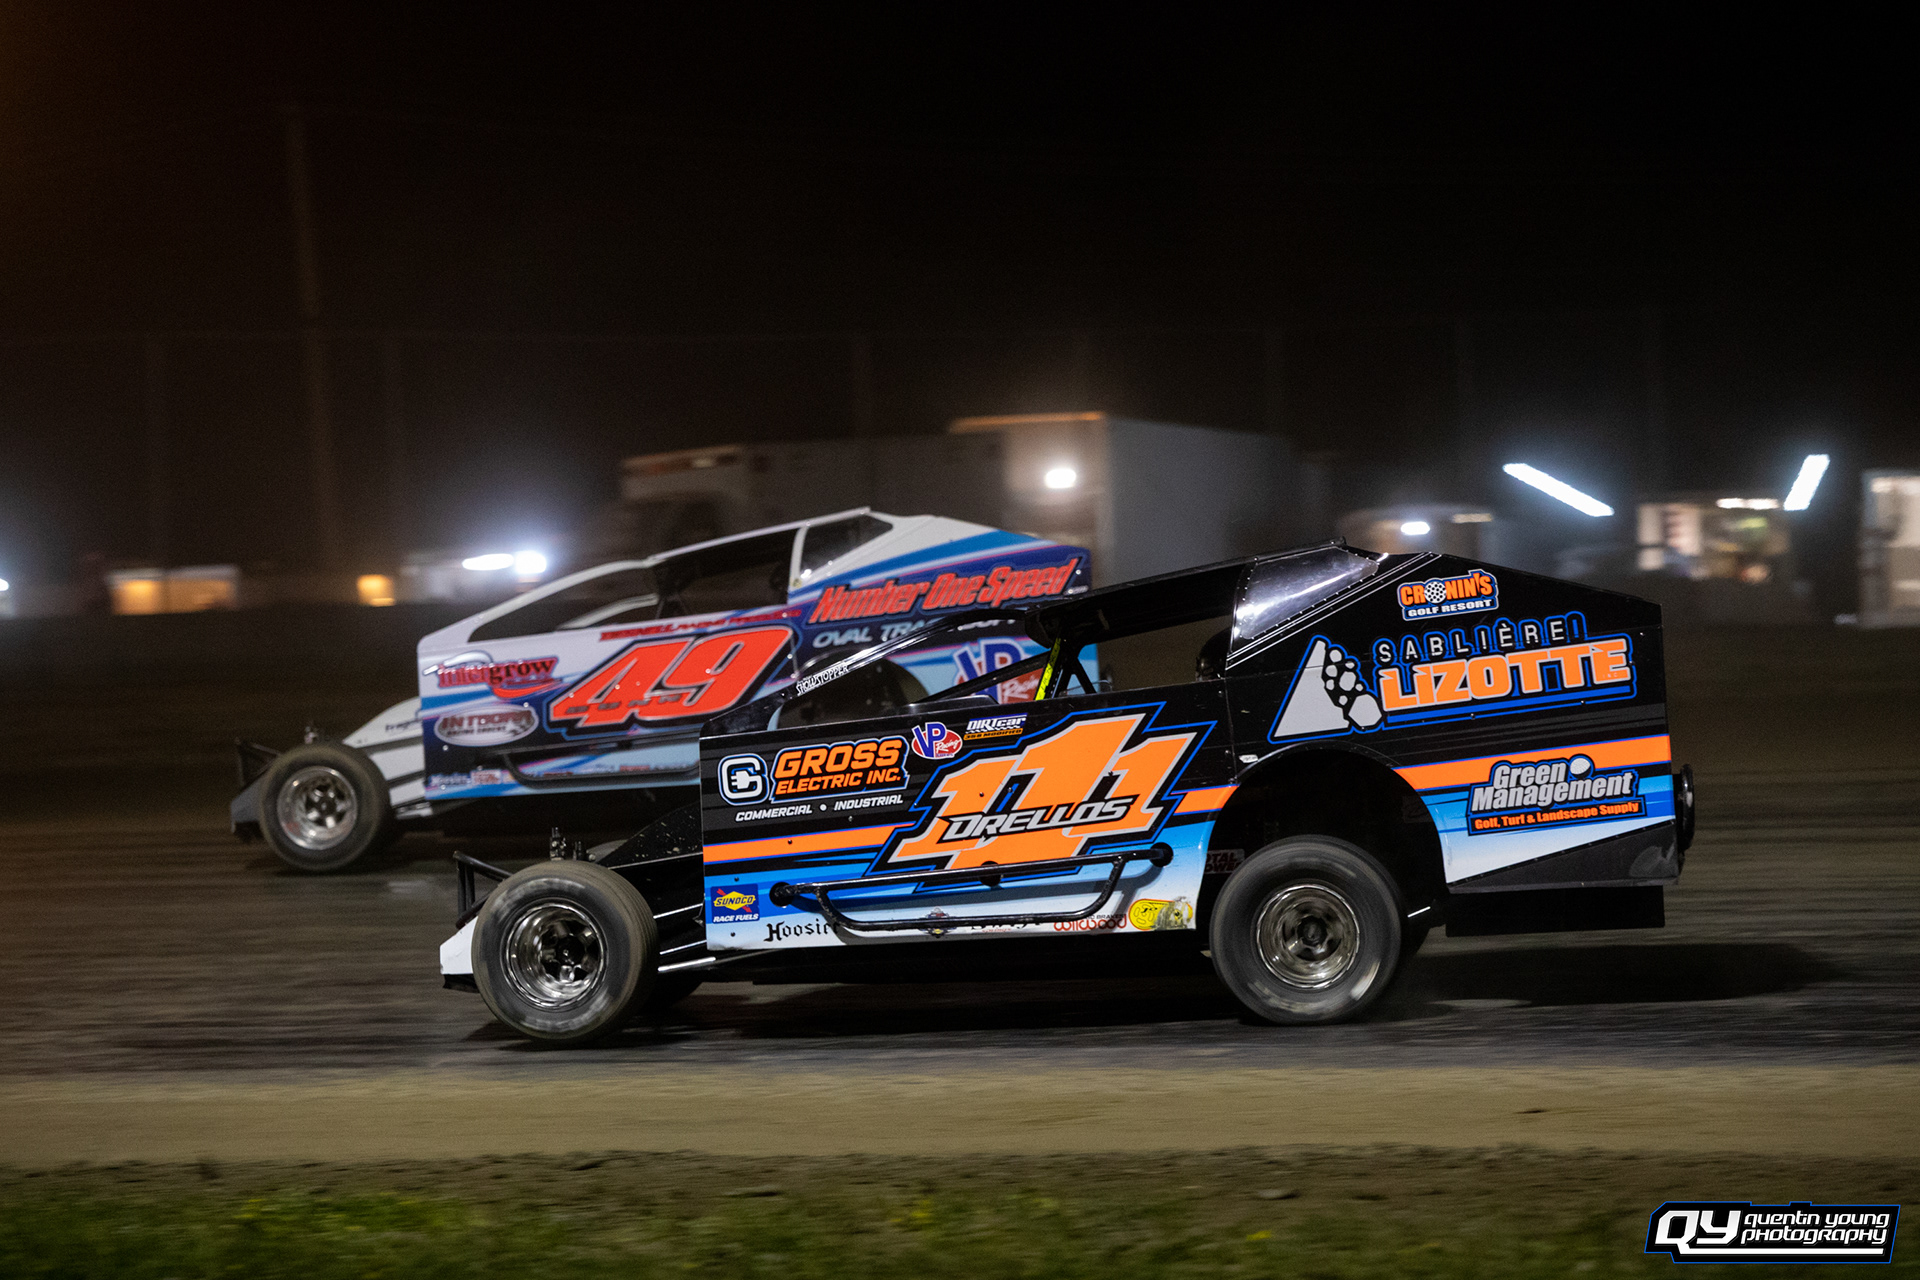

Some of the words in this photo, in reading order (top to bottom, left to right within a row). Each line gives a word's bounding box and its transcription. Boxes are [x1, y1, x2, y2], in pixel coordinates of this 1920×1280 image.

[809, 579, 929, 624] Number
[922, 571, 983, 611] One
[976, 558, 1081, 608] Speed
[1407, 606, 1442, 618] GOLF
[1446, 600, 1492, 614] RESORT
[813, 628, 872, 649] OVAL
[549, 625, 794, 728] 49
[1378, 638, 1632, 711] LIZOTTE
[911, 722, 947, 758] VP
[936, 739, 961, 753] Racing
[775, 739, 903, 779] GROSS
[1494, 759, 1567, 789] Green
[775, 772, 864, 795] ELECTRIC
[866, 767, 901, 785] INC.
[1470, 771, 1633, 813] Management
[735, 804, 812, 822] COMMERCIAL
[834, 794, 904, 811] INDUSTRIAL
[1474, 816, 1501, 831] Golf,
[1502, 812, 1525, 826] Turf
[1527, 813, 1535, 825] &
[1537, 806, 1599, 823] Landscape
[1601, 801, 1640, 818] Supply
[715, 895, 754, 906] SUNOCO
[736, 913, 759, 922] FUELS
